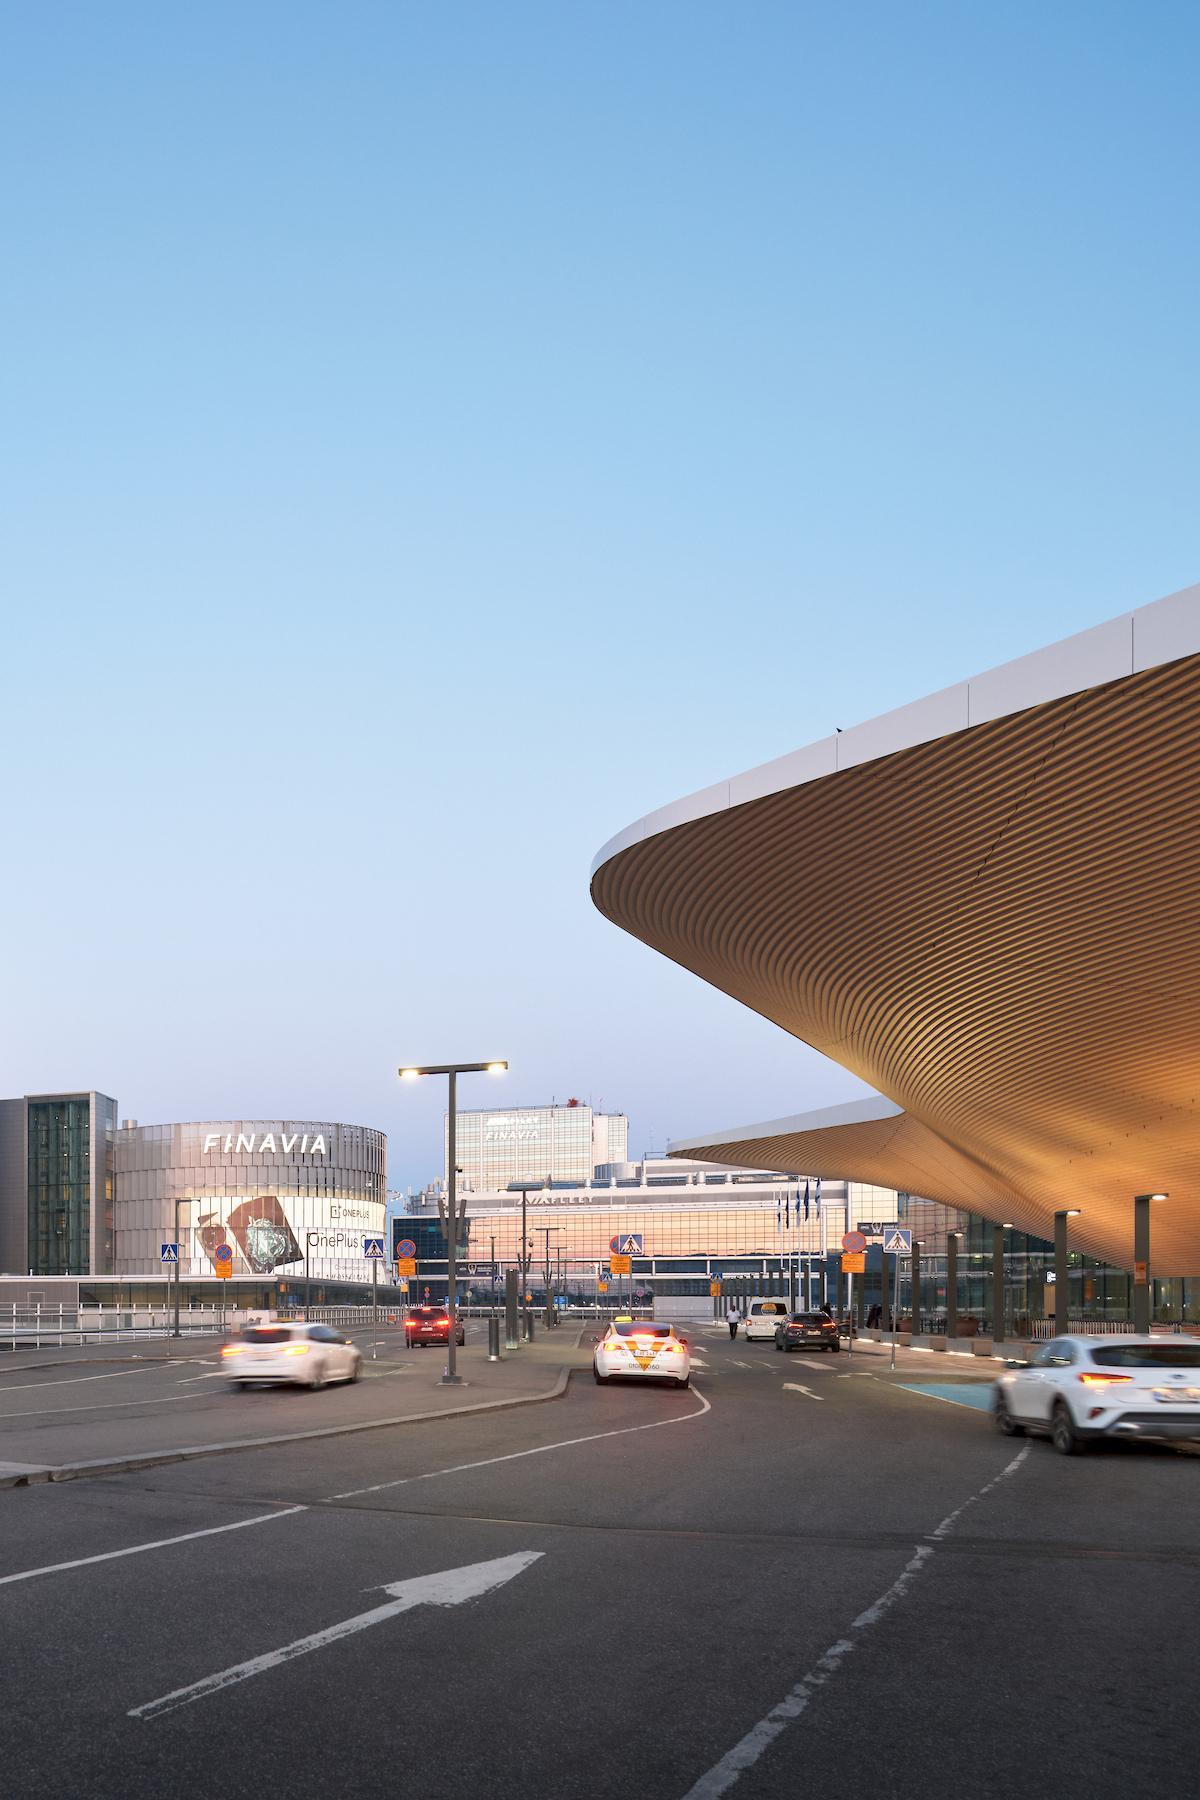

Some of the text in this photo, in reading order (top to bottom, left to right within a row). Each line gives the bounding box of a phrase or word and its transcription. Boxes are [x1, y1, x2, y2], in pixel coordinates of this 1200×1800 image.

[203, 1133, 326, 1154] FINAVIA
[343, 1208, 369, 1219] ONEPLUS
[308, 1232, 358, 1249] OnePlus
